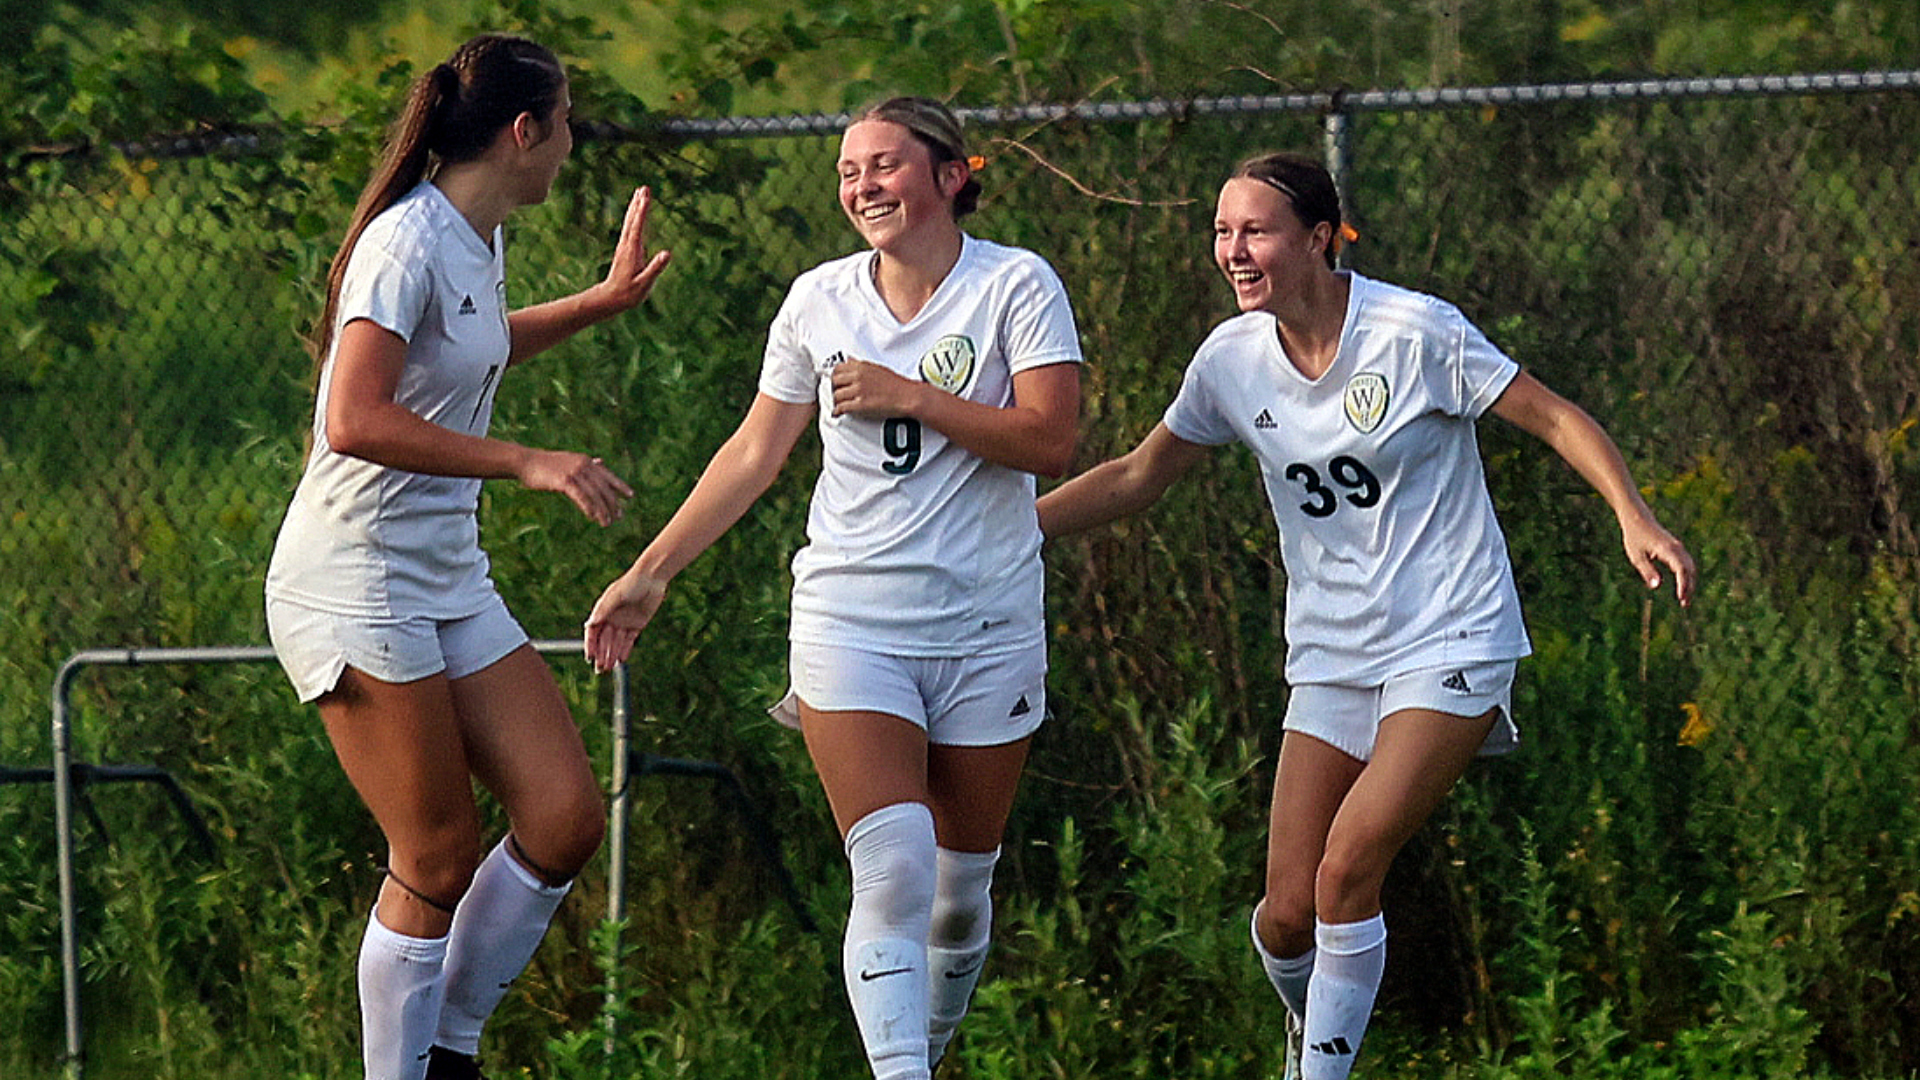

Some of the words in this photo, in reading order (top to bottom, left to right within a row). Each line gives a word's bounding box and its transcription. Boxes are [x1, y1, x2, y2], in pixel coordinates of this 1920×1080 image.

[932, 349, 961, 373] W
[1352, 387, 1375, 411] W
[881, 417, 922, 475] 9
[1285, 456, 1381, 518] 39
